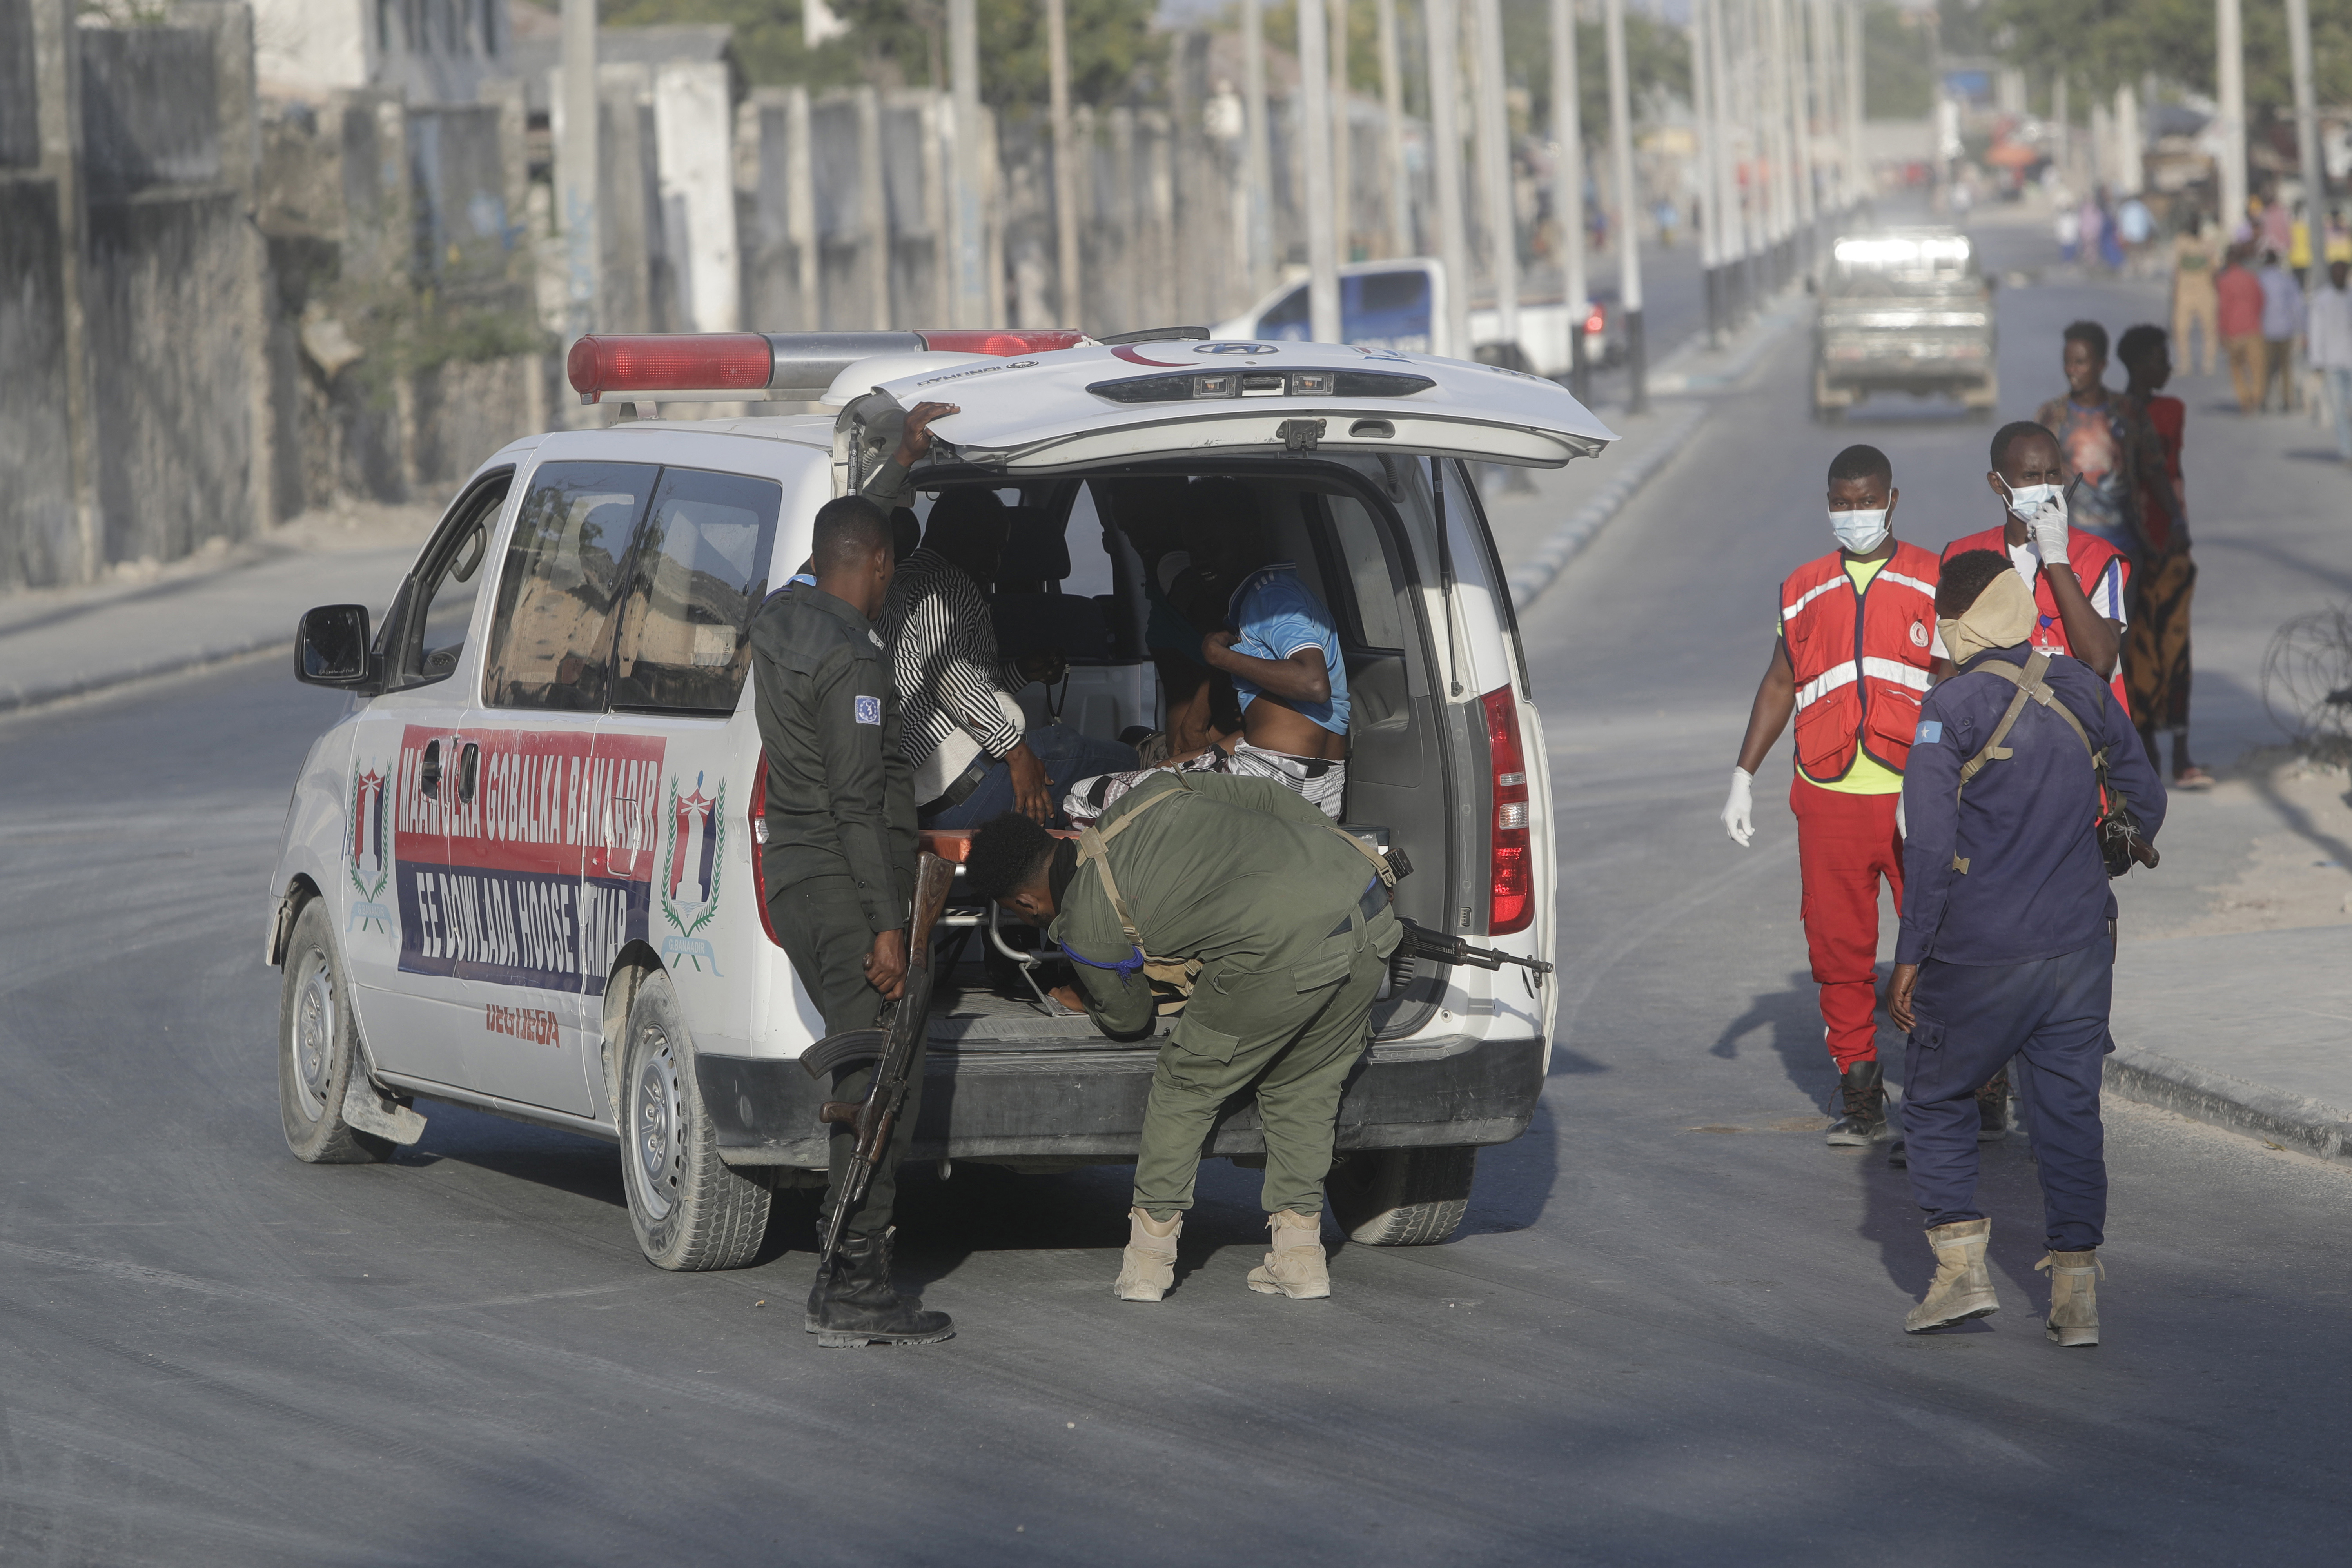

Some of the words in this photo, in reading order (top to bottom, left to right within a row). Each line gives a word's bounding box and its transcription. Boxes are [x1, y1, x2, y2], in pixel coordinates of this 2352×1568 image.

[486, 751, 563, 844] GOBALKA
[566, 756, 658, 852] BANAADIR
[416, 872, 441, 958] EE
[439, 873, 518, 967] DOWLADA
[516, 880, 574, 973] HOOSE
[668, 938, 705, 954] G.BANAADIR
